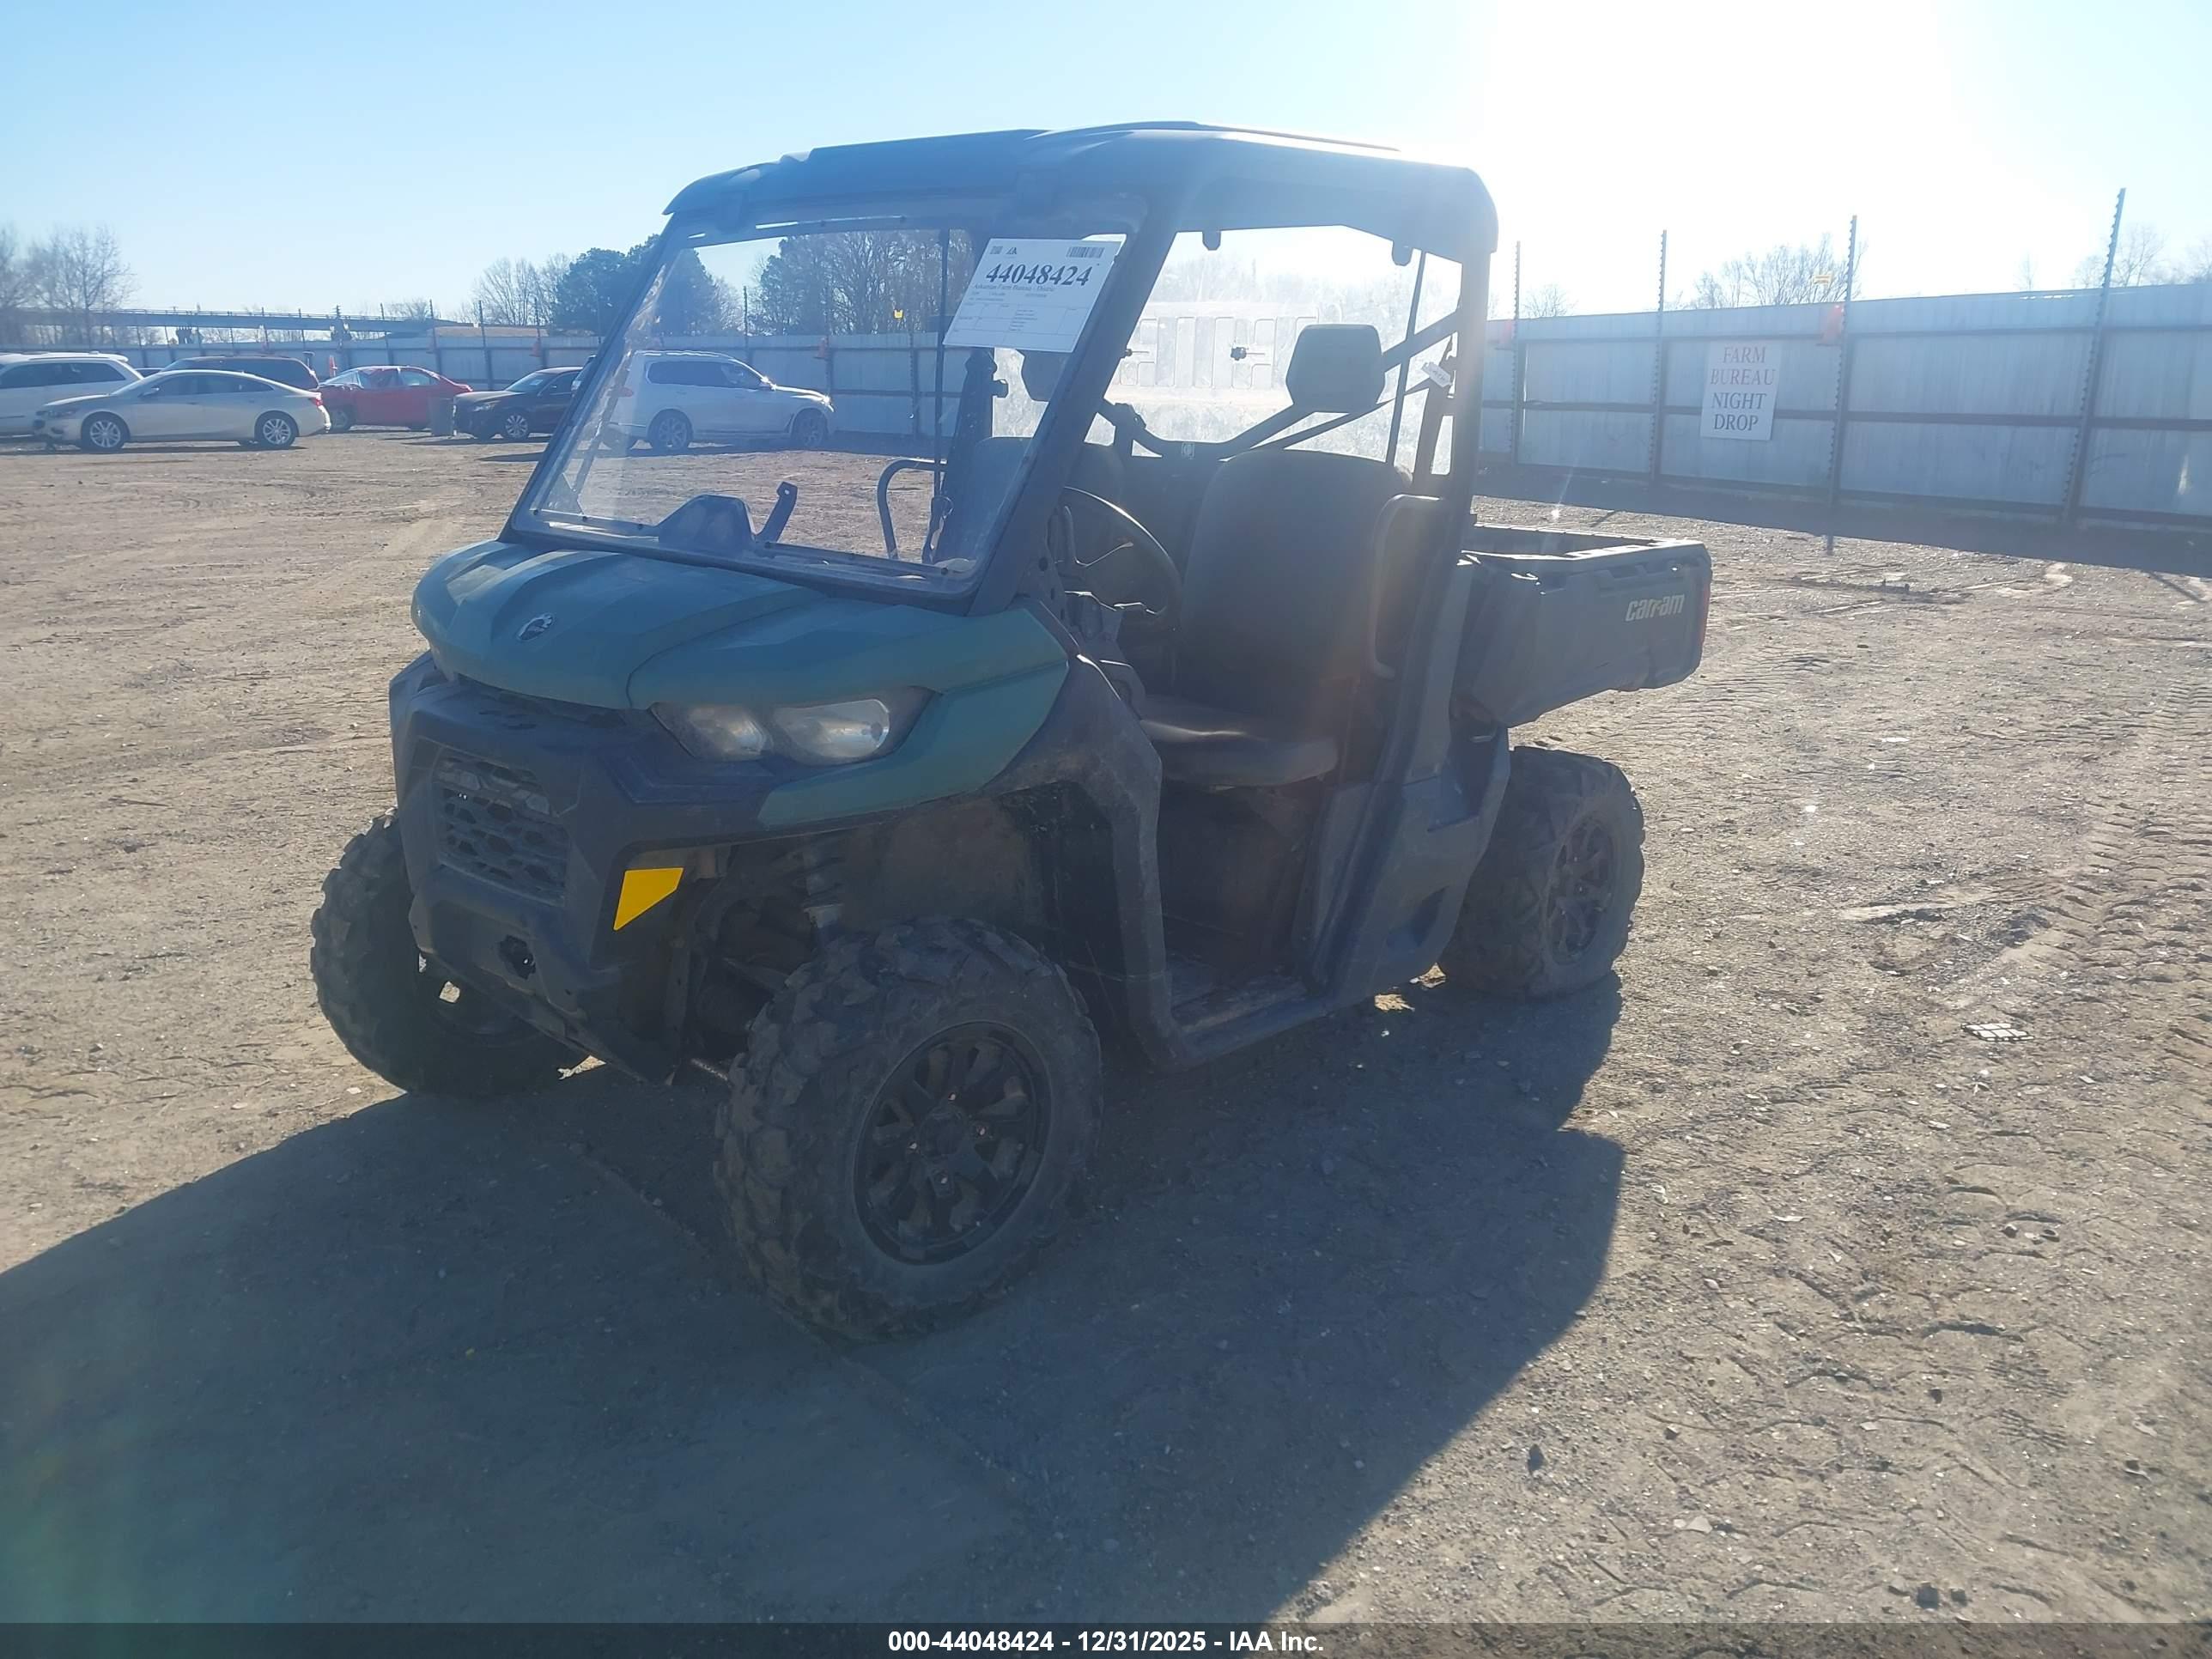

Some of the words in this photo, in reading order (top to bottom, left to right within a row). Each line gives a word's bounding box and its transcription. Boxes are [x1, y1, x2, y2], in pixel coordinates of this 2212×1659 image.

[986, 263, 1093, 286] 44048424
[1723, 346, 1766, 363] FARM
[1711, 368, 1776, 386] BUREAU
[1711, 392, 1767, 410] NIGHT
[1713, 413, 1759, 431] DROP
